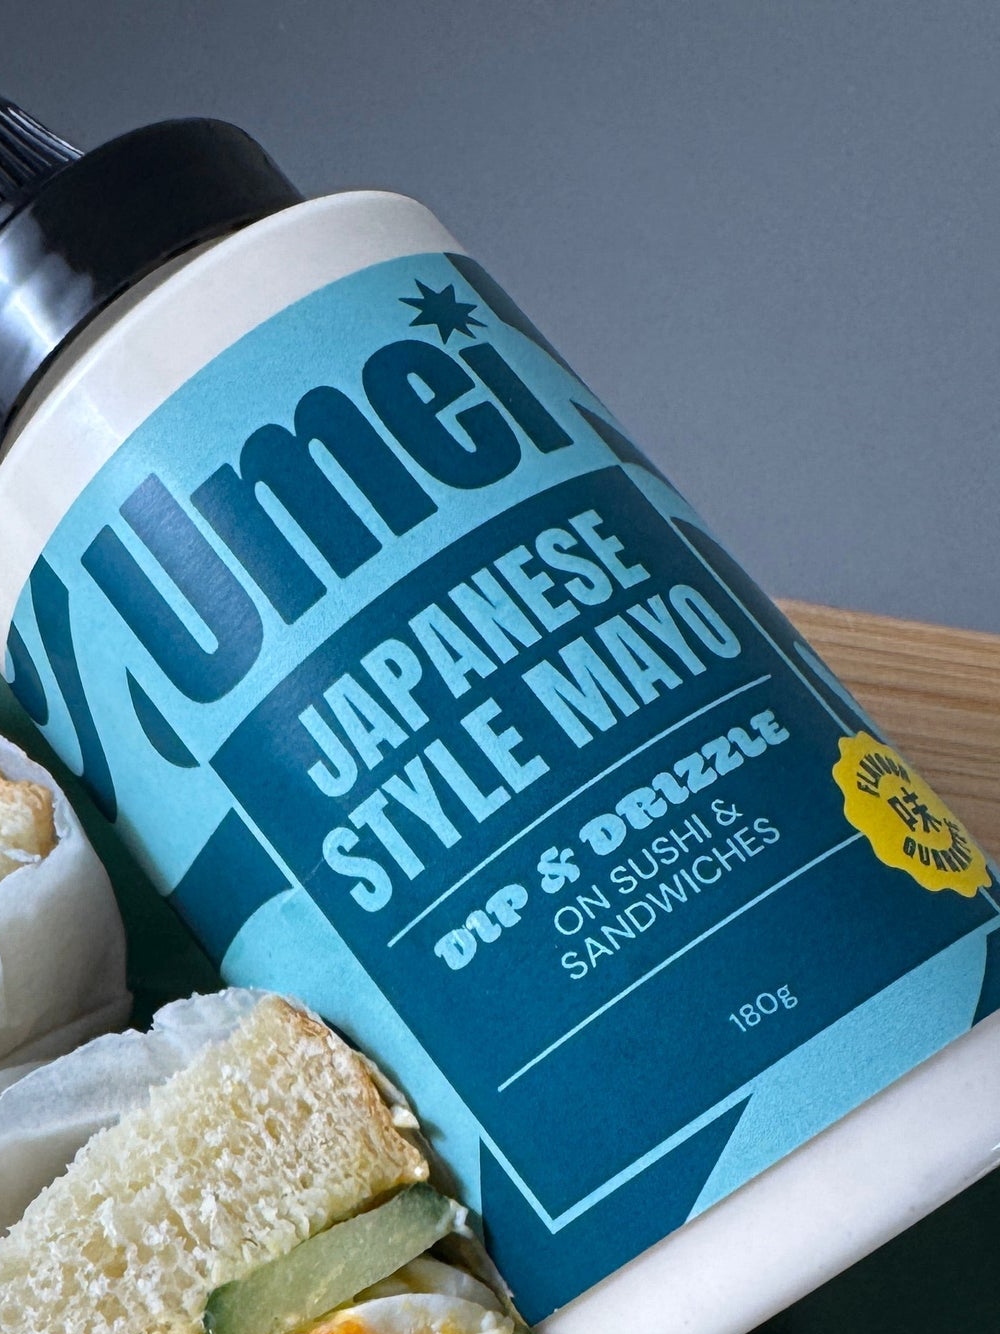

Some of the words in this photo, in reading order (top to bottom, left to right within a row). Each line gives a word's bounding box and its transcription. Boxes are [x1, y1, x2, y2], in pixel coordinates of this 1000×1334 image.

[298, 509, 651, 797] JAPANESE
[322, 697, 550, 912] STYLE
[521, 584, 742, 748] MAYO
[537, 846, 581, 894] &
[579, 709, 790, 856] DRIZZLE
[887, 786, 943, 834] 味
[554, 884, 611, 935] ON
[610, 813, 713, 894] SUSHI
[711, 799, 743, 826] &
[561, 818, 781, 980] SANDWICHES
[728, 984, 799, 1033] 180g
